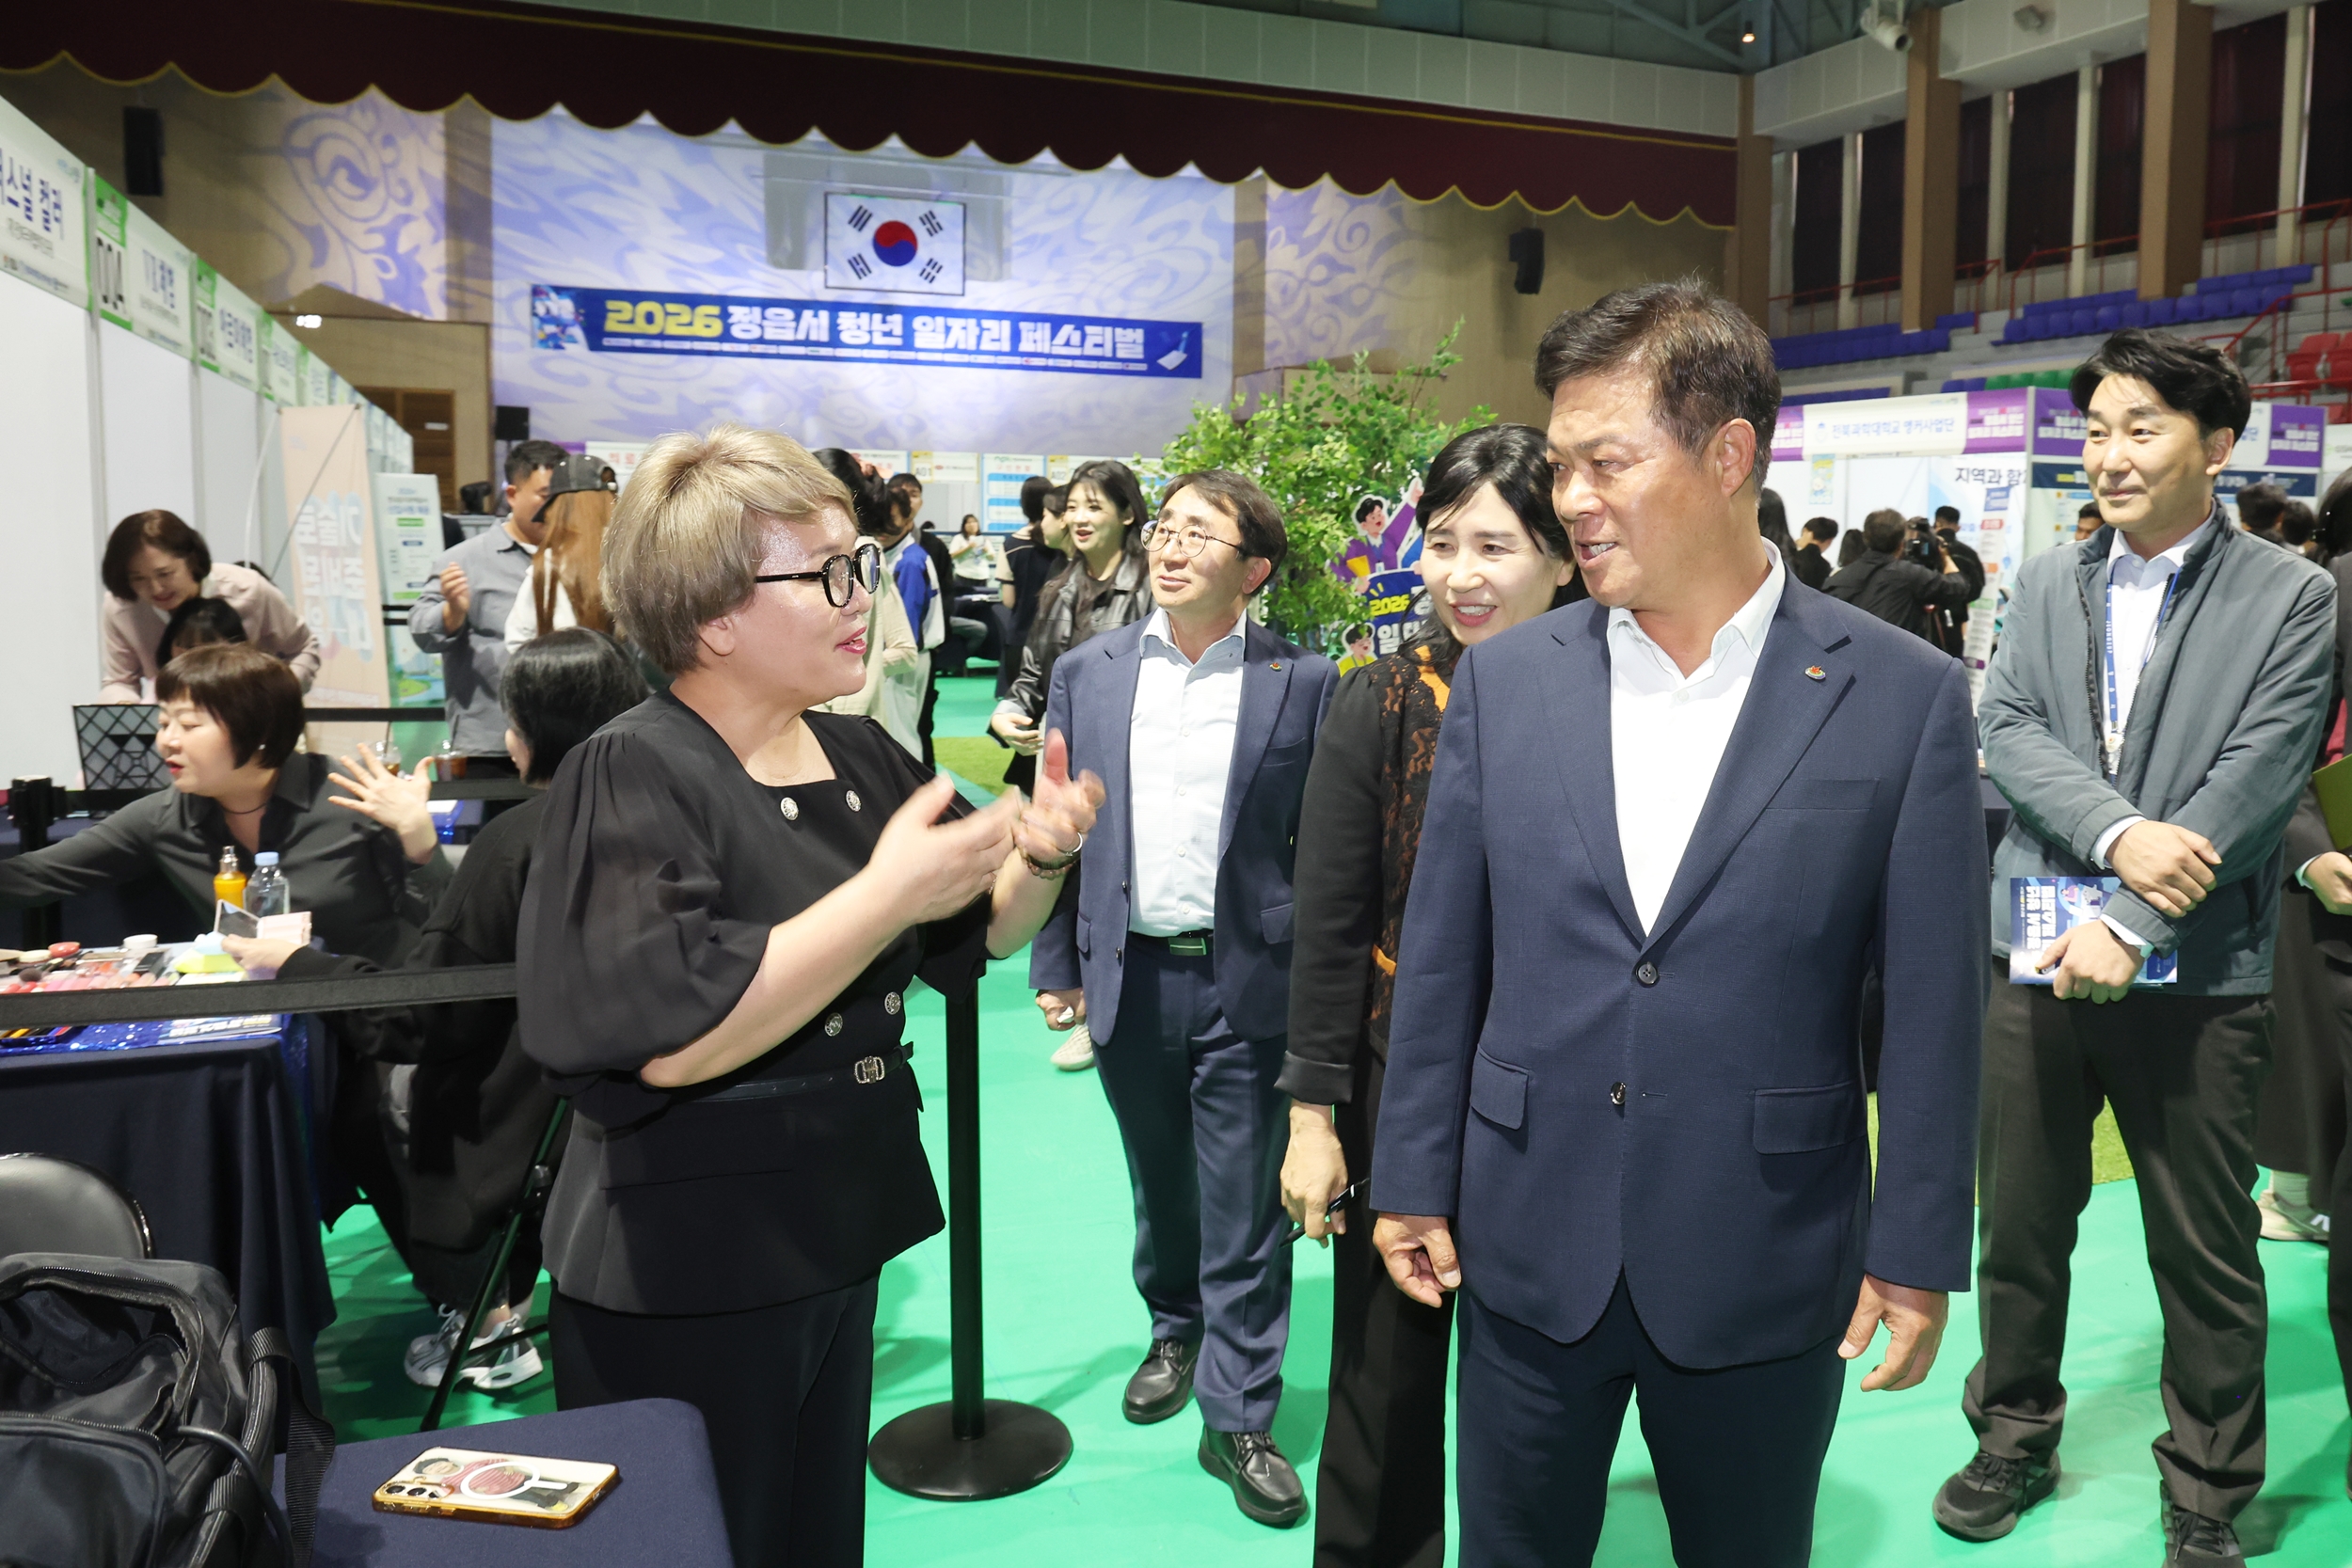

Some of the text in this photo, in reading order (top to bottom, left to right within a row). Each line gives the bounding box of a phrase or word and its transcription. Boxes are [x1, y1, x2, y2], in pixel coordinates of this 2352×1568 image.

[0, 149, 33, 222] 스널
[604, 300, 1145, 359] 2026 정읍시 청년 일자리 페스티벌
[915, 467, 932, 477] A01
[1956, 467, 2026, 486] 지역과 함
[1369, 594, 1411, 617] 2026
[2026, 885, 2042, 950] 정읍시 청년
[2041, 885, 2057, 938] 페스티벌
